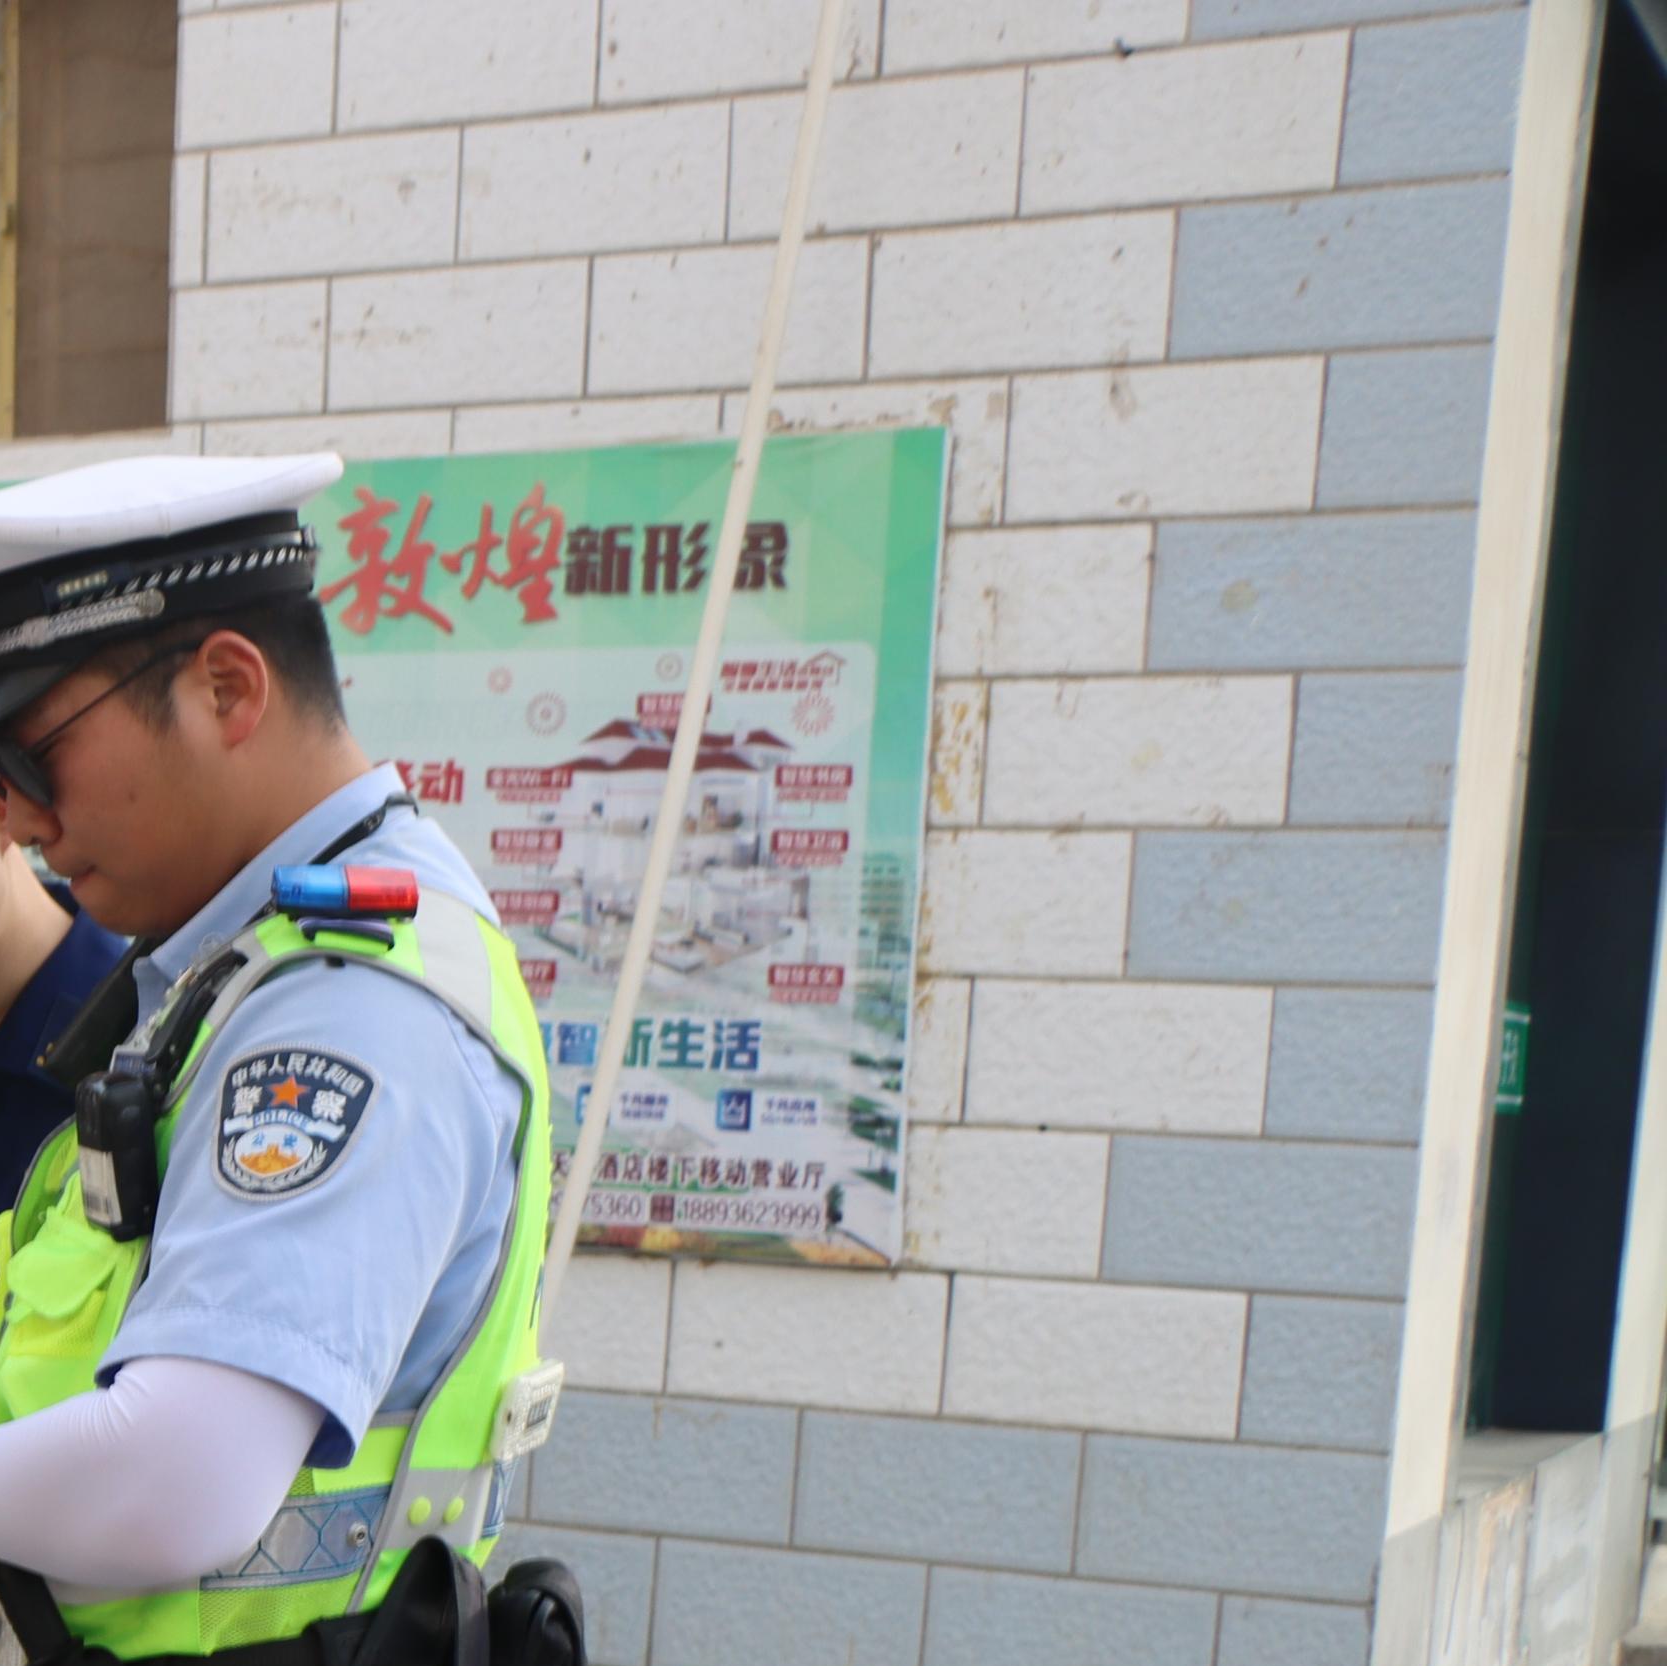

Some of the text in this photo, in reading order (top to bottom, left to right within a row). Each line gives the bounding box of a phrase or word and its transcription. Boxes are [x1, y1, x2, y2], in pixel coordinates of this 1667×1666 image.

[231, 1052, 365, 1098] 中华人民共和国
[552, 1154, 825, 1191] 天酒店楼下移动营业厅
